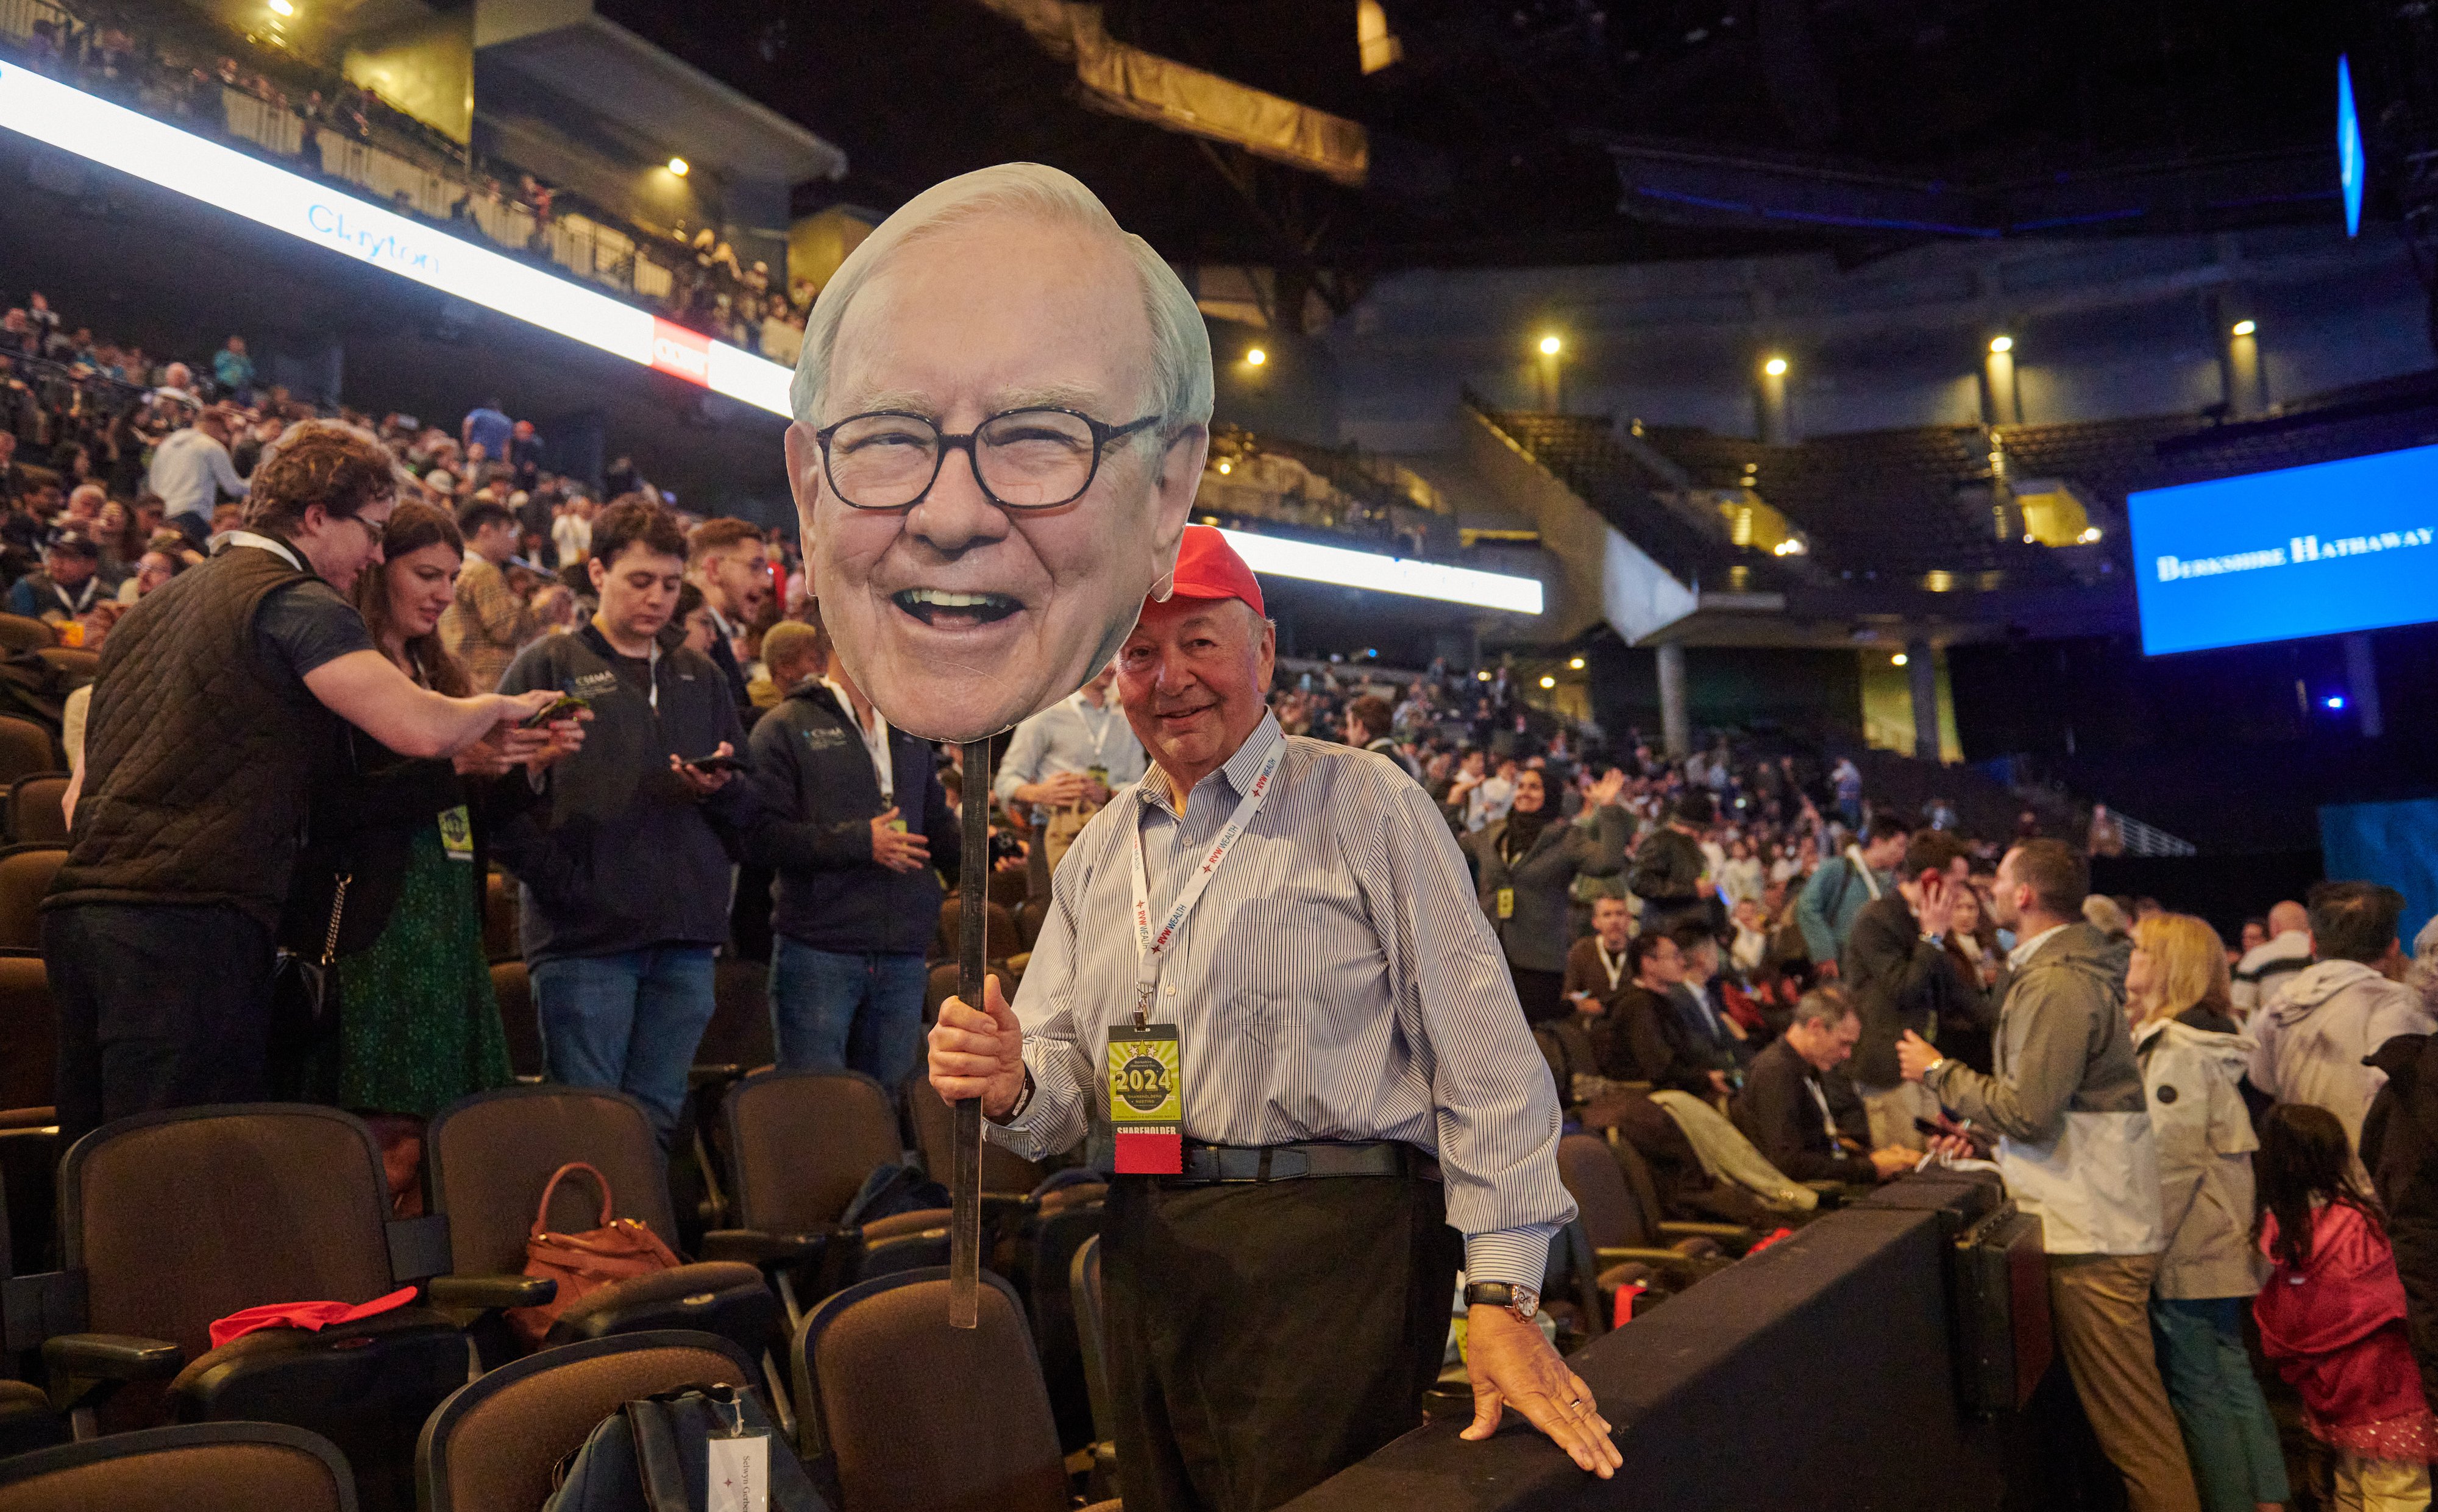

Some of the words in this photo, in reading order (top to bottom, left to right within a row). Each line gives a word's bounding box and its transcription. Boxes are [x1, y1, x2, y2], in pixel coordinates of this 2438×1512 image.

[2156, 547, 2286, 583] BERKSHIRE
[2289, 526, 2436, 564] HATHAWAY
[1115, 1068, 1171, 1090] 2024
[741, 1455, 750, 1485] Selwyn
